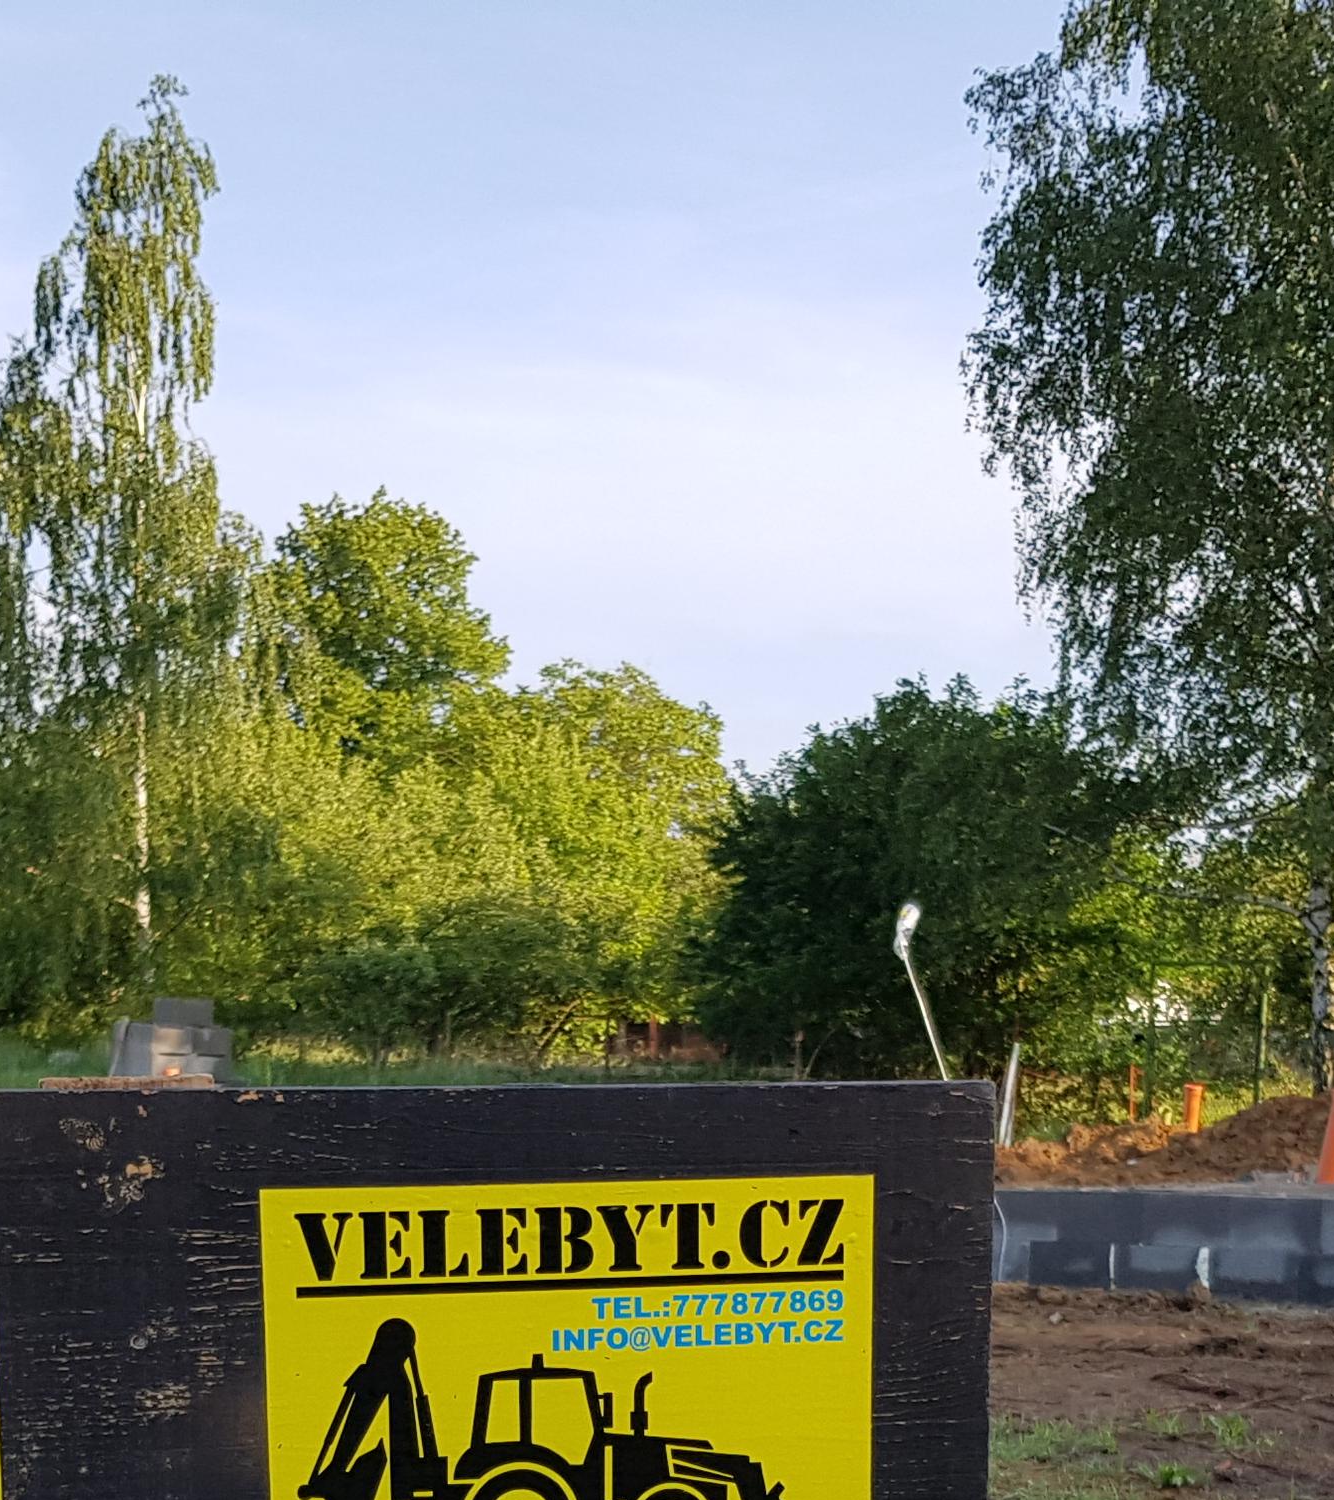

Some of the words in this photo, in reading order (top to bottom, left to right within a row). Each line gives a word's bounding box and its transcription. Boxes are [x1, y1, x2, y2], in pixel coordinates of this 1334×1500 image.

[295, 1199, 845, 1281] VELEBYT.CZ
[592, 1289, 844, 1320] TEL.:777877869
[552, 1319, 843, 1352] INFO@VELEBYT.CZ
